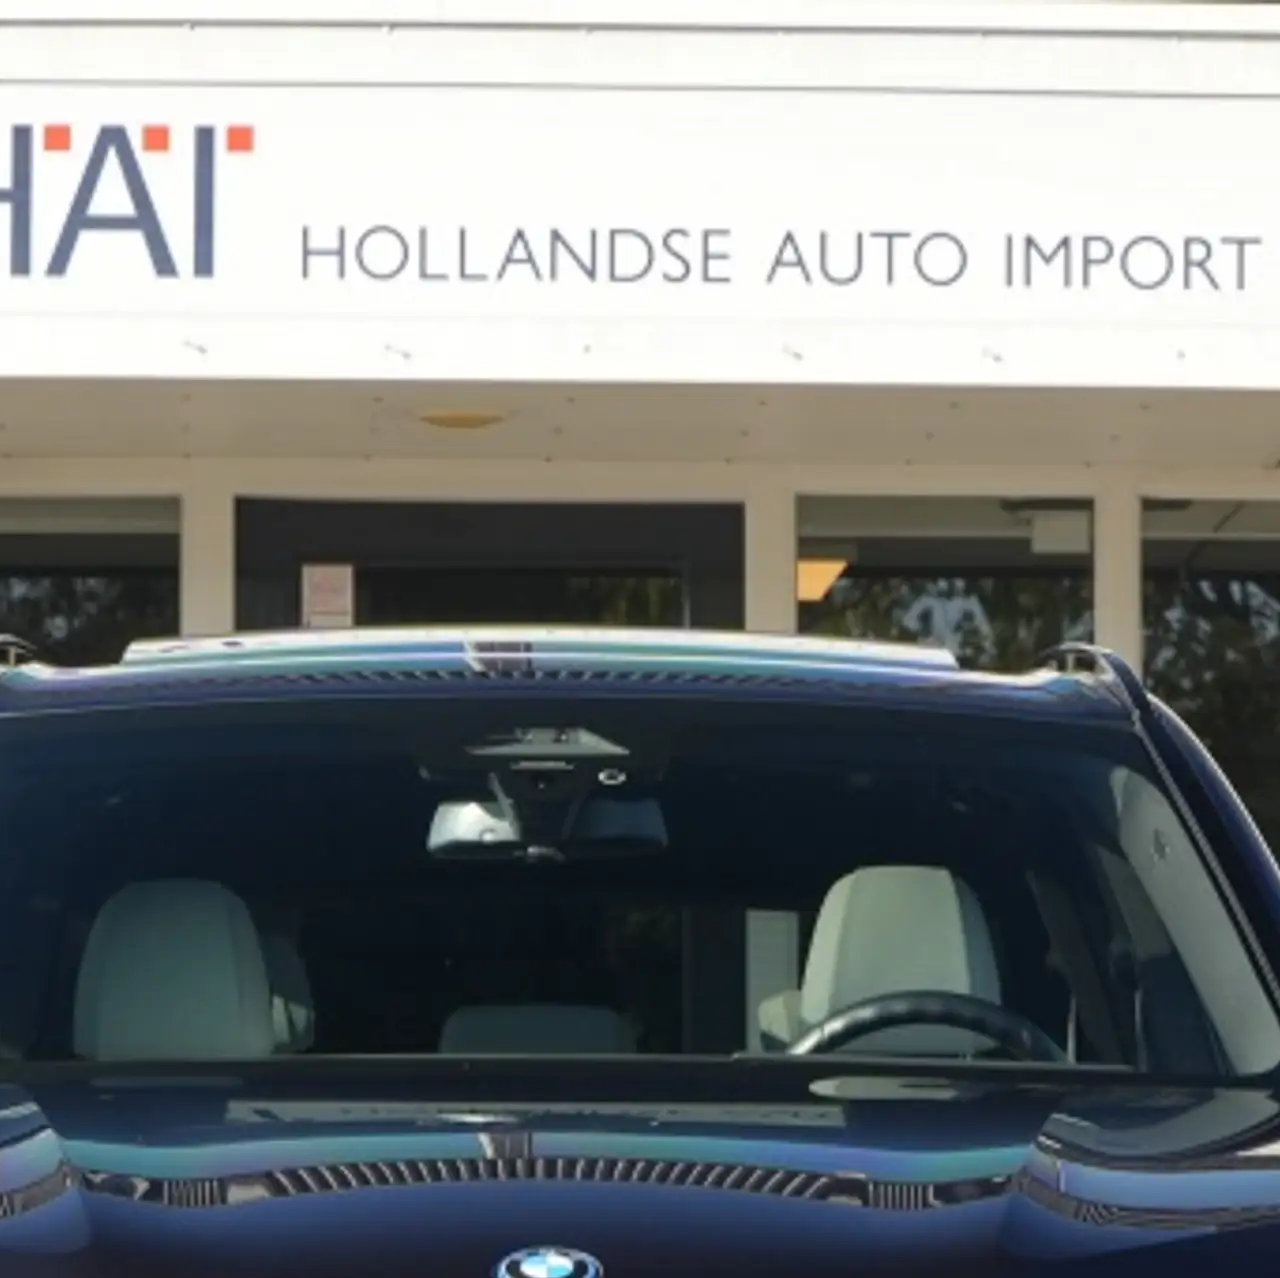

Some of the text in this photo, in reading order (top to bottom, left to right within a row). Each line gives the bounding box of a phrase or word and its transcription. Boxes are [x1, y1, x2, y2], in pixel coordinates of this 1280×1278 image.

[301, 226, 1262, 291] HOLLANDSE AUTO IMPORT
